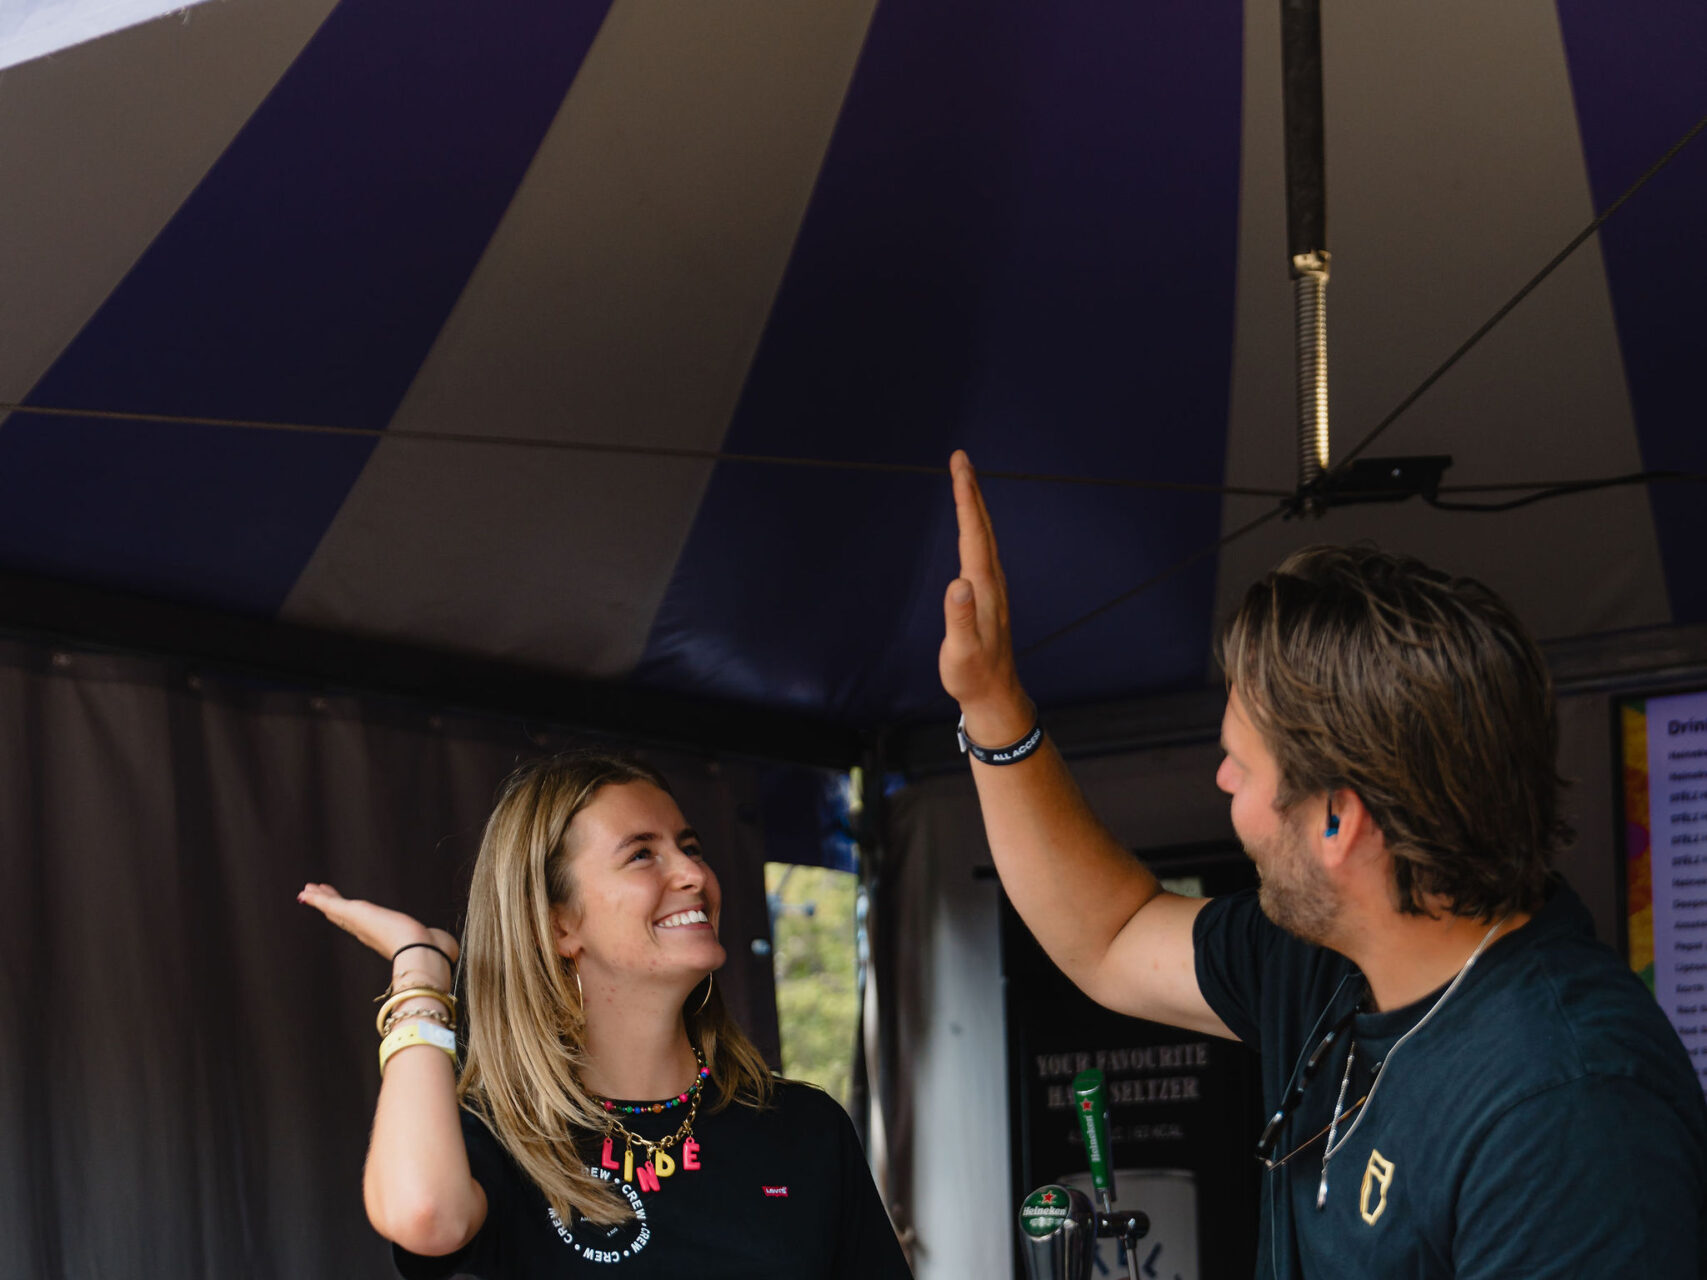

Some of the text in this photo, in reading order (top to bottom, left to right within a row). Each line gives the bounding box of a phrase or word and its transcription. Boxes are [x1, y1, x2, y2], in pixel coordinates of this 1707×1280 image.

[1037, 1043, 1208, 1076] YOUR FAVOURITE
[1109, 1077, 1198, 1102] SELTZER
[1083, 1114, 1101, 1162] Heineken
[602, 1137, 701, 1192] LINDE
[621, 1184, 647, 1220] CREW
[1022, 1206, 1067, 1217] Heineken
[547, 1207, 573, 1244] CREW
[631, 1227, 650, 1254] CREW
[582, 1247, 620, 1263] CREW
